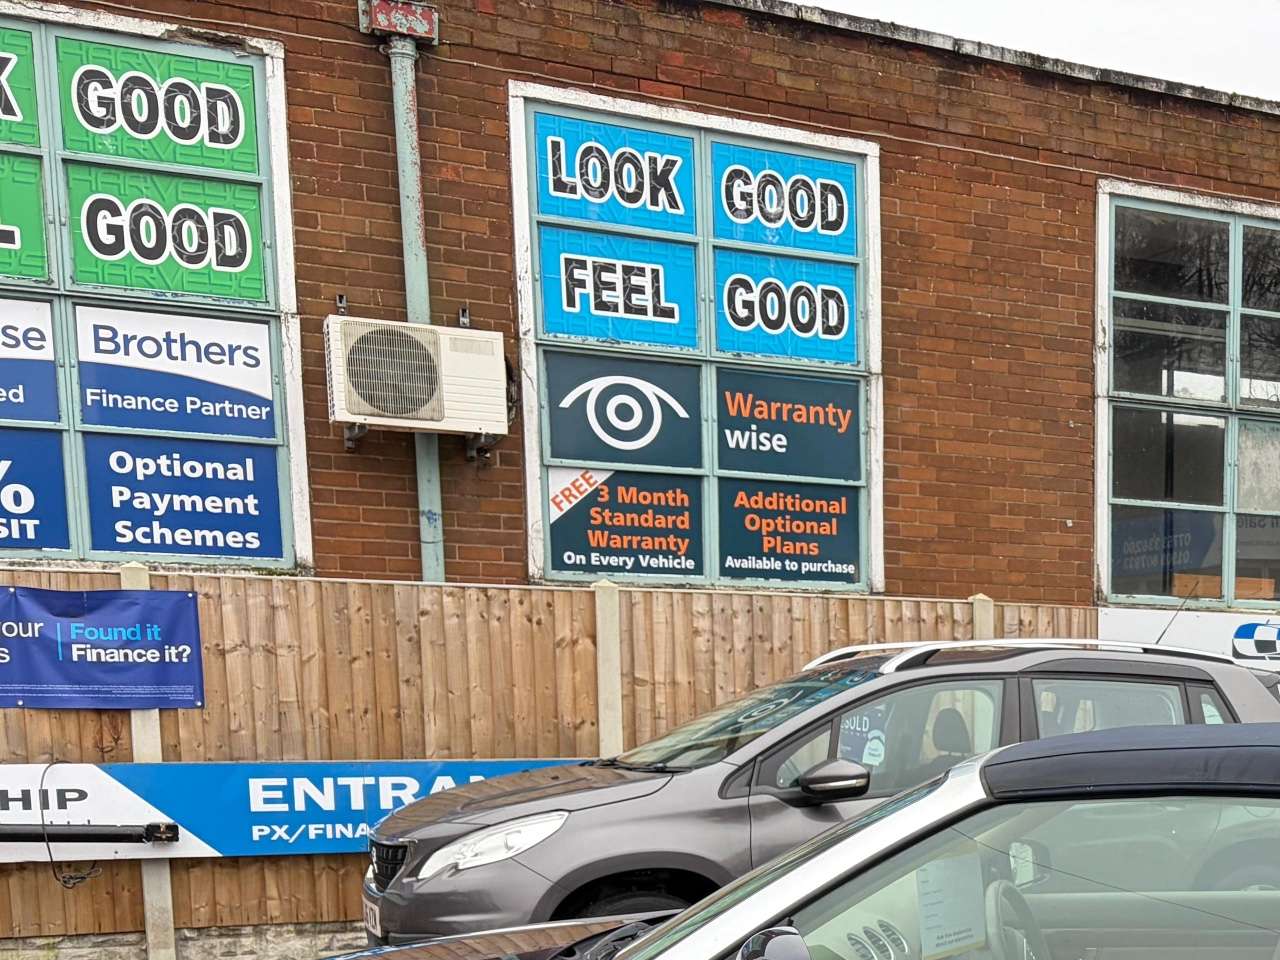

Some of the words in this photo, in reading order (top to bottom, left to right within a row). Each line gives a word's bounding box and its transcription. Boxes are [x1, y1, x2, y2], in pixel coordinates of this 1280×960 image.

[75, 67, 242, 147] GOOD
[548, 138, 683, 212] LOOK
[724, 167, 846, 234] GOOD
[84, 196, 249, 270] GOOD
[562, 256, 678, 321] FEEL
[726, 277, 848, 338] GOOD
[0, 324, 47, 351] se
[92, 323, 261, 369] Brothers
[86, 388, 179, 413] Finance
[186, 396, 271, 420] Partner
[724, 391, 852, 434] Warranty
[724, 425, 788, 454] wise
[109, 450, 254, 482] Optional
[112, 486, 259, 516] Payment
[550, 470, 599, 513] FREE
[597, 485, 610, 503] 3
[617, 486, 690, 507] Month
[734, 491, 847, 515] Additional
[590, 508, 690, 530] Standard
[744, 514, 838, 536] Optional
[114, 520, 261, 549] Schemes
[587, 531, 690, 556] Warranty
[762, 536, 820, 556] Plans
[563, 551, 586, 566] On
[590, 553, 635, 570] Every
[638, 554, 695, 570] Vehicle
[725, 556, 782, 571] Available
[785, 559, 798, 572] to
[801, 559, 855, 575] purchase
[0, 621, 44, 638] our
[71, 623, 142, 641] Found
[146, 624, 161, 641] it
[71, 644, 160, 663] Finance
[164, 645, 192, 663] it?
